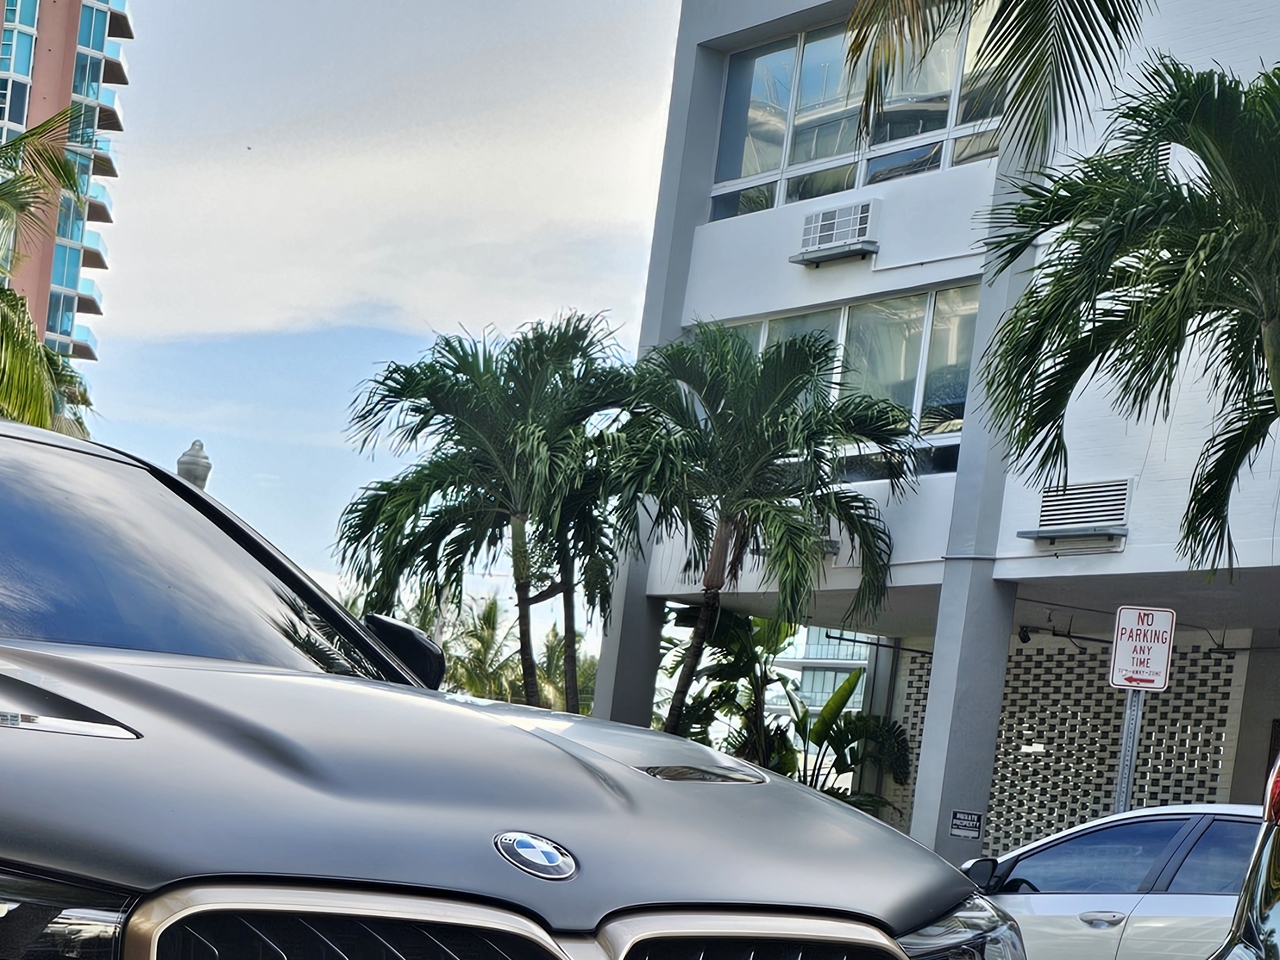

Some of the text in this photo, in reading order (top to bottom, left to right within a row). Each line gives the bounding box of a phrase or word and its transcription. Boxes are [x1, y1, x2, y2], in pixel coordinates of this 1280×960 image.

[1137, 612, 1154, 627] NO
[1120, 627, 1168, 645] PARKING
[1132, 645, 1153, 656] ANY
[1131, 657, 1151, 668] TIME
